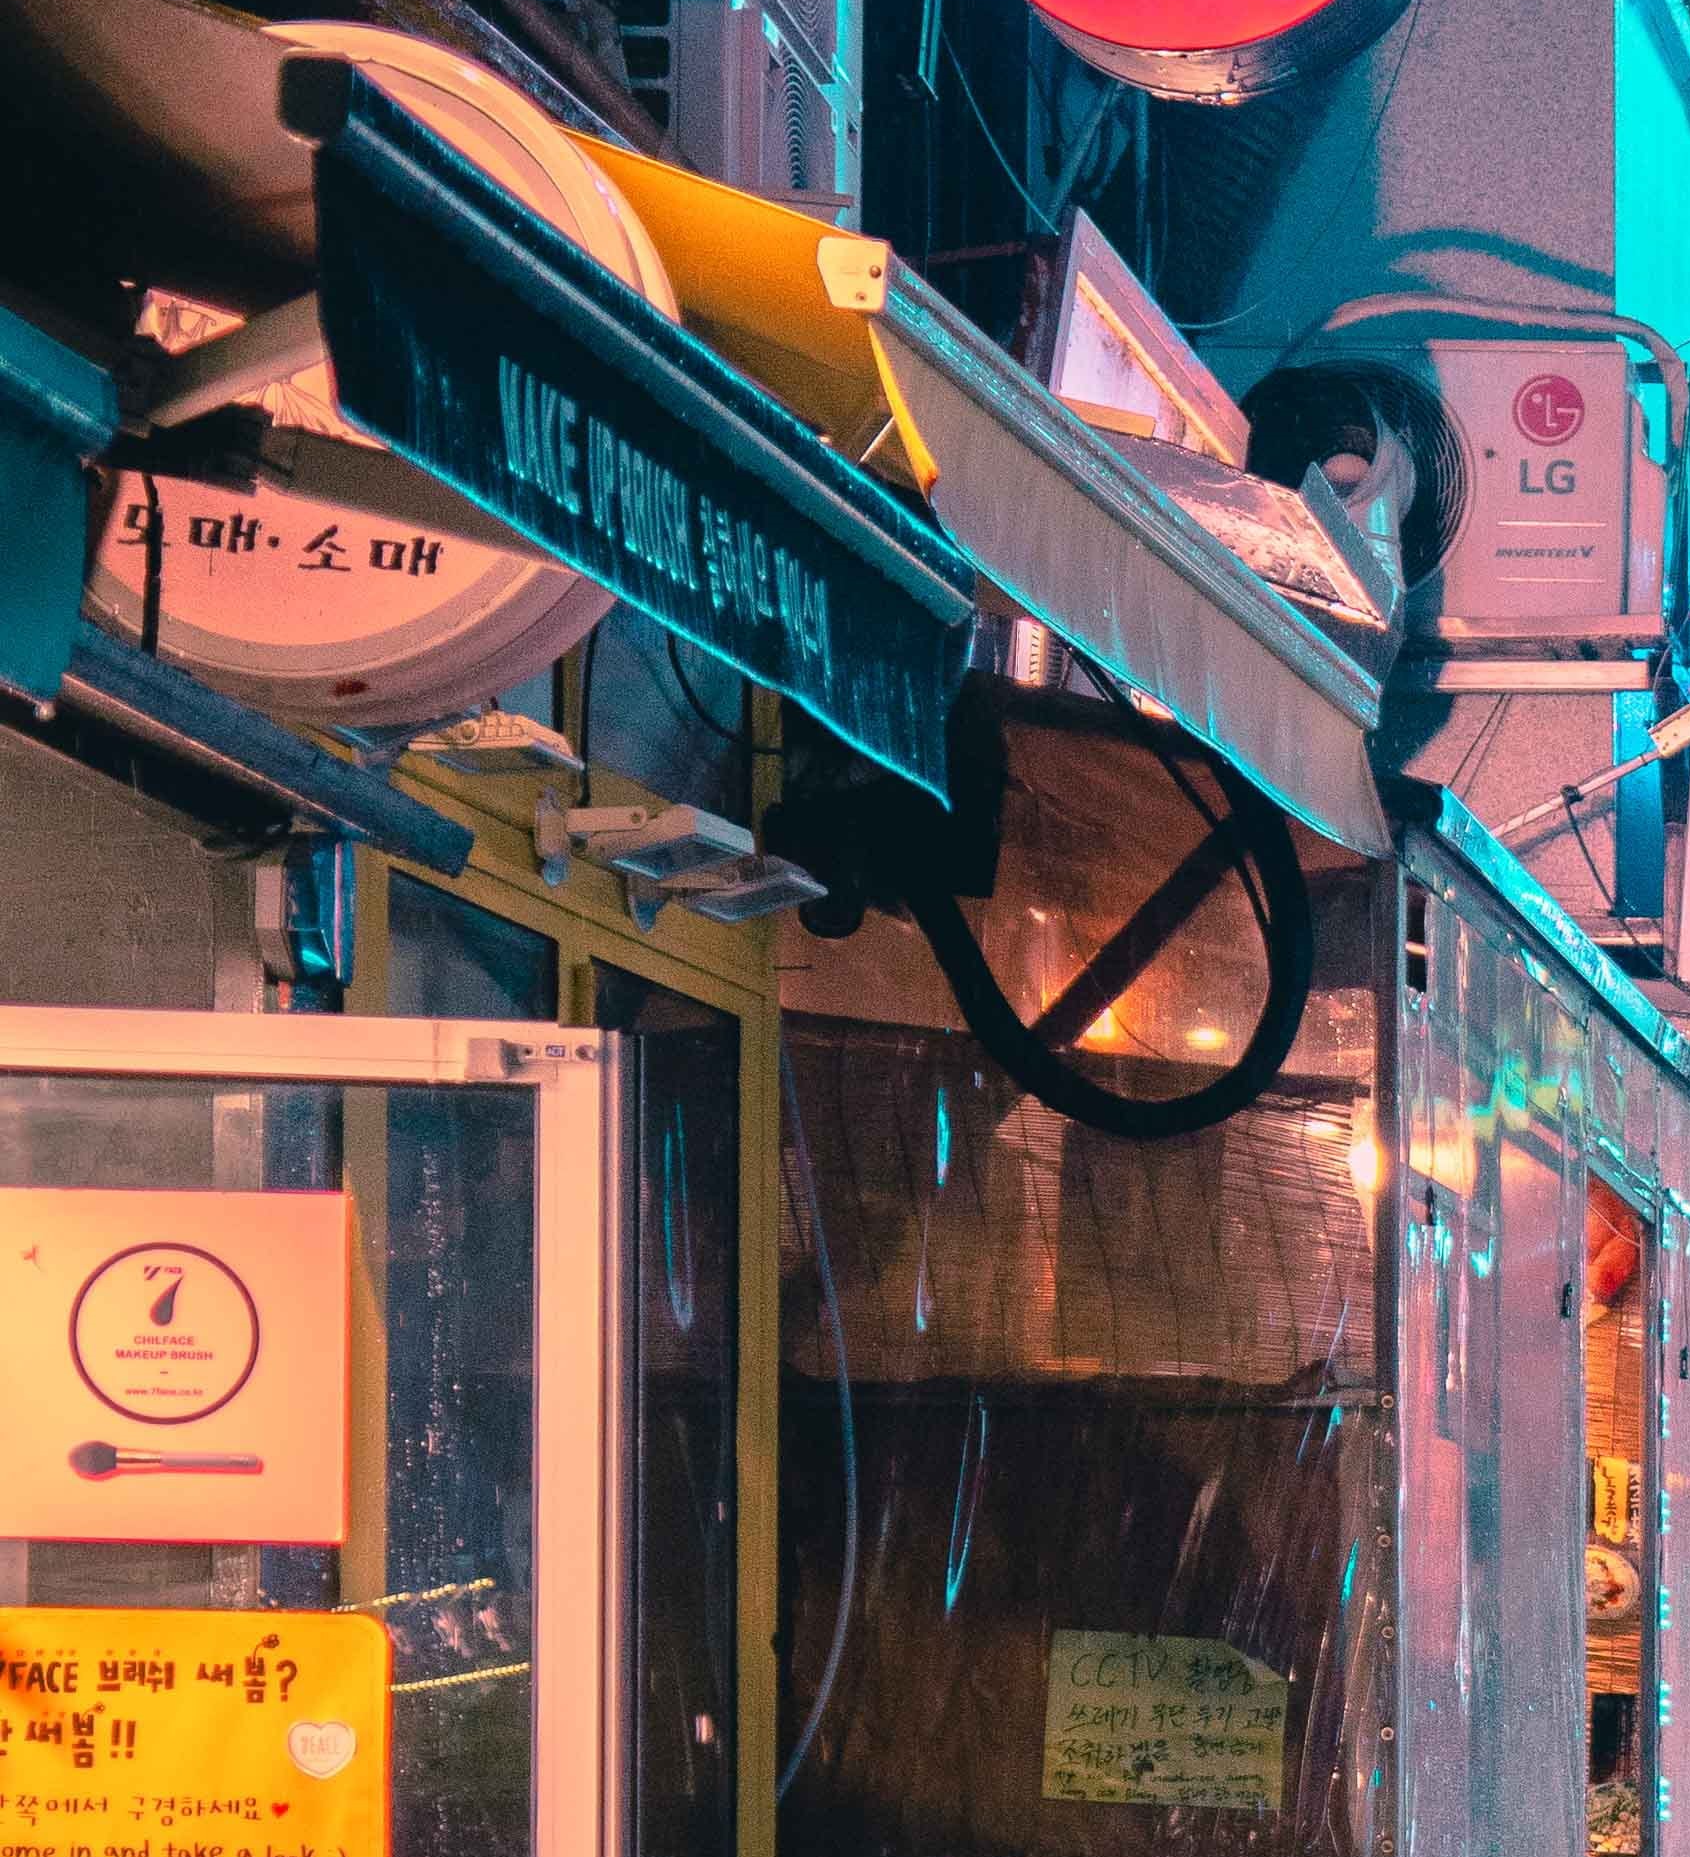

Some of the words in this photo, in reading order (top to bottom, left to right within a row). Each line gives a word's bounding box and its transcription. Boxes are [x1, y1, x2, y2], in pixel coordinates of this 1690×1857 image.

[1519, 458, 1576, 494] LG
[115, 1349, 169, 1361] MAKEUP
[170, 1350, 214, 1362] BRUSH
[133, 1335, 195, 1347] CHILFACE
[97, 1659, 175, 1694] 브러쉬
[128, 1796, 262, 1827] 구경하세요
